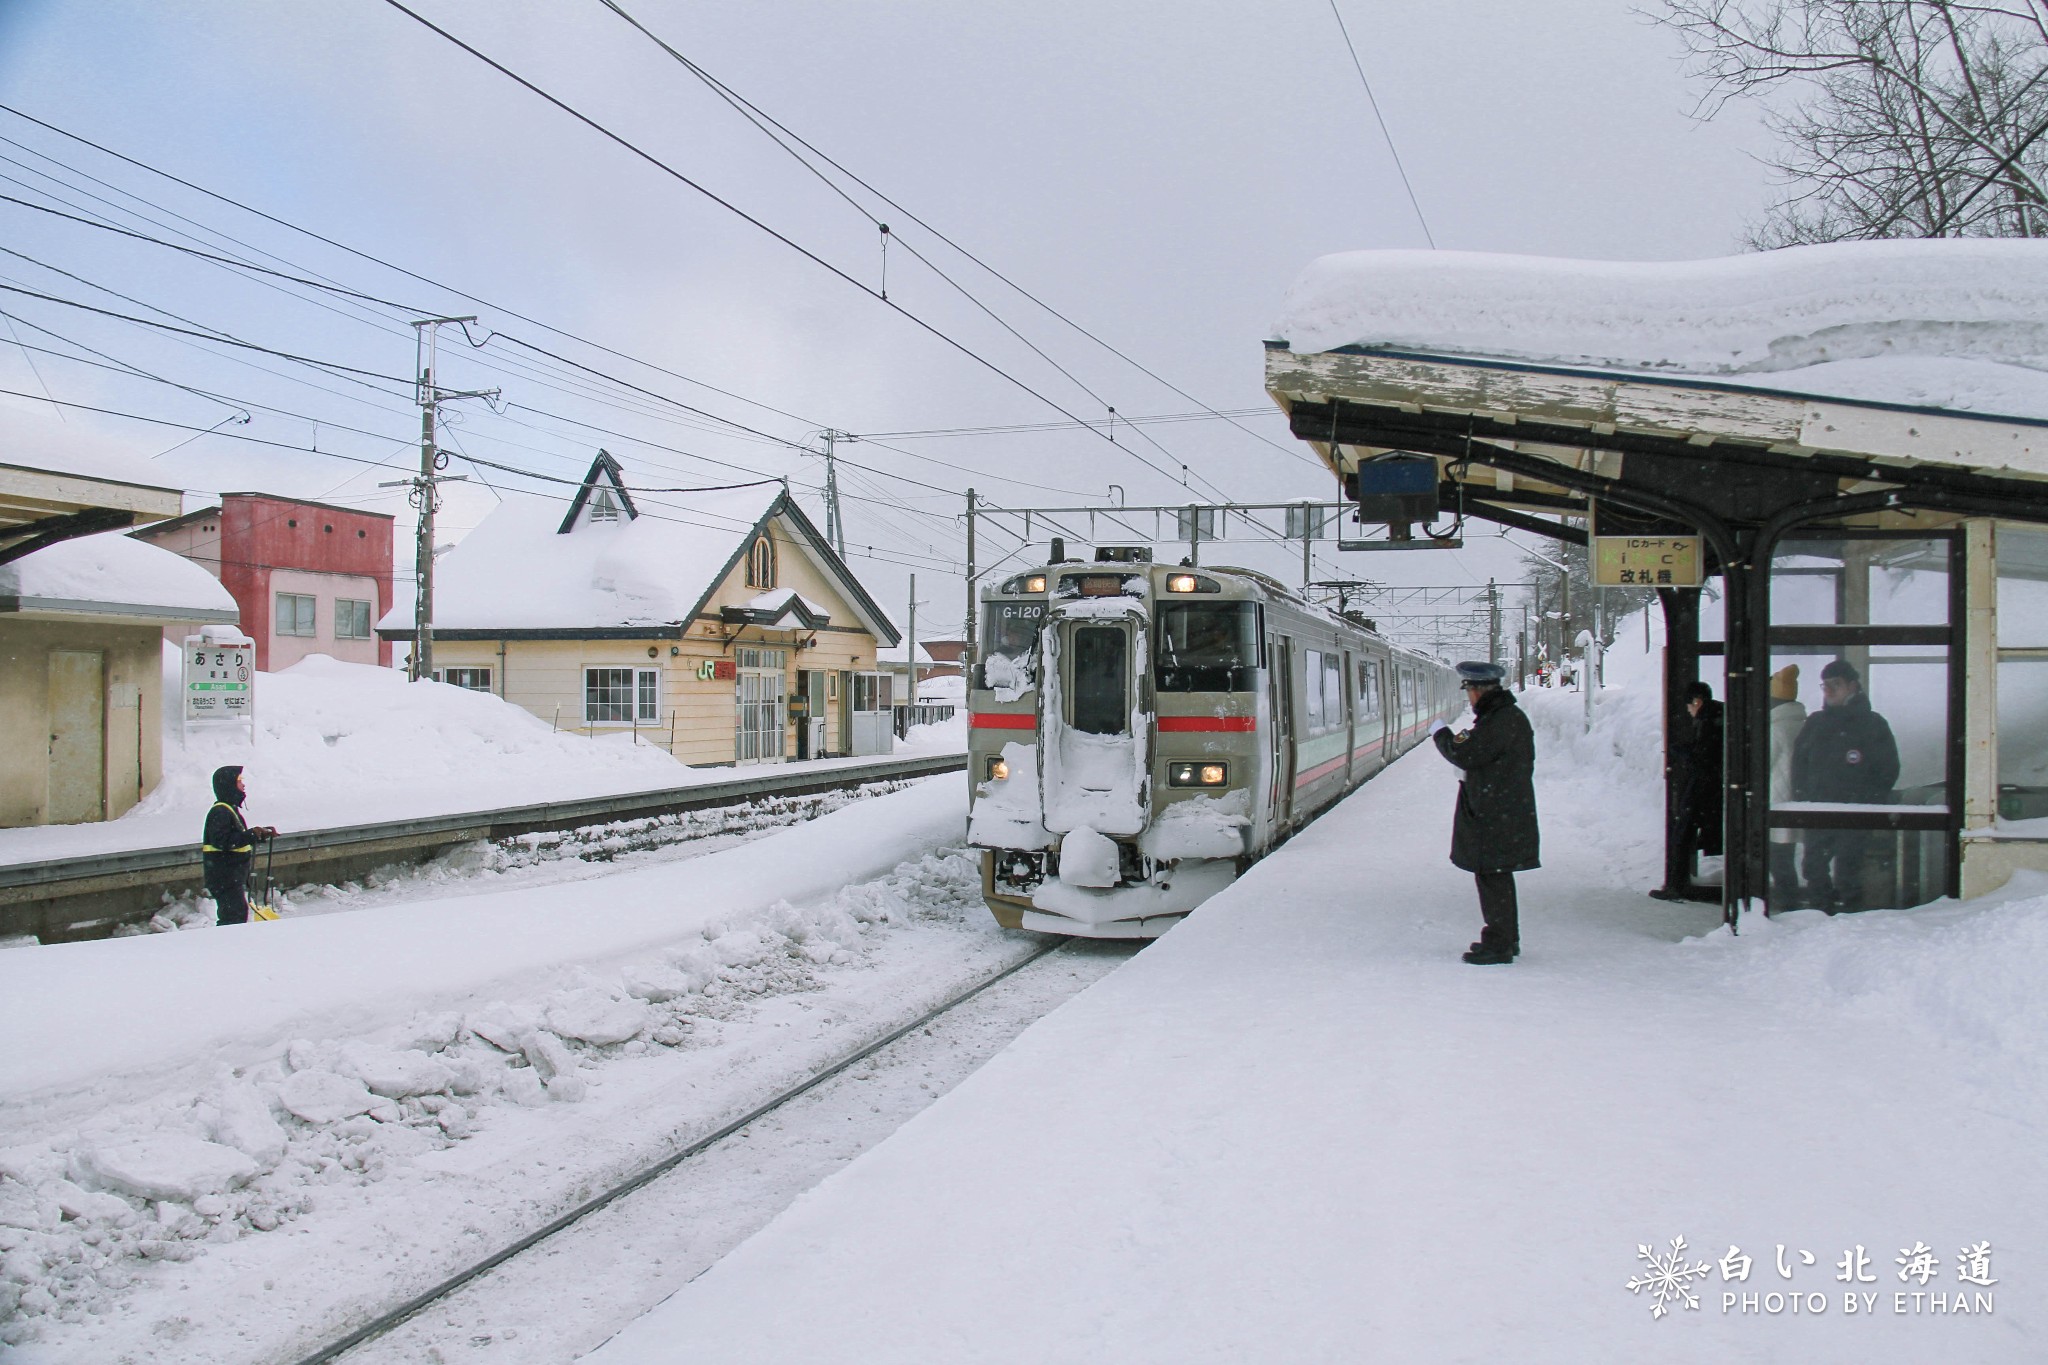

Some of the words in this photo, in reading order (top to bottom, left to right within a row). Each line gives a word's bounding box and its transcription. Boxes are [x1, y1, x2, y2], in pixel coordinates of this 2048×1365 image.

[1627, 540, 1665, 548] ICカード
[1620, 569, 1672, 583] 改札機
[1003, 606, 1040, 618] G-120
[195, 652, 243, 667] あさり
[698, 661, 715, 680] JR
